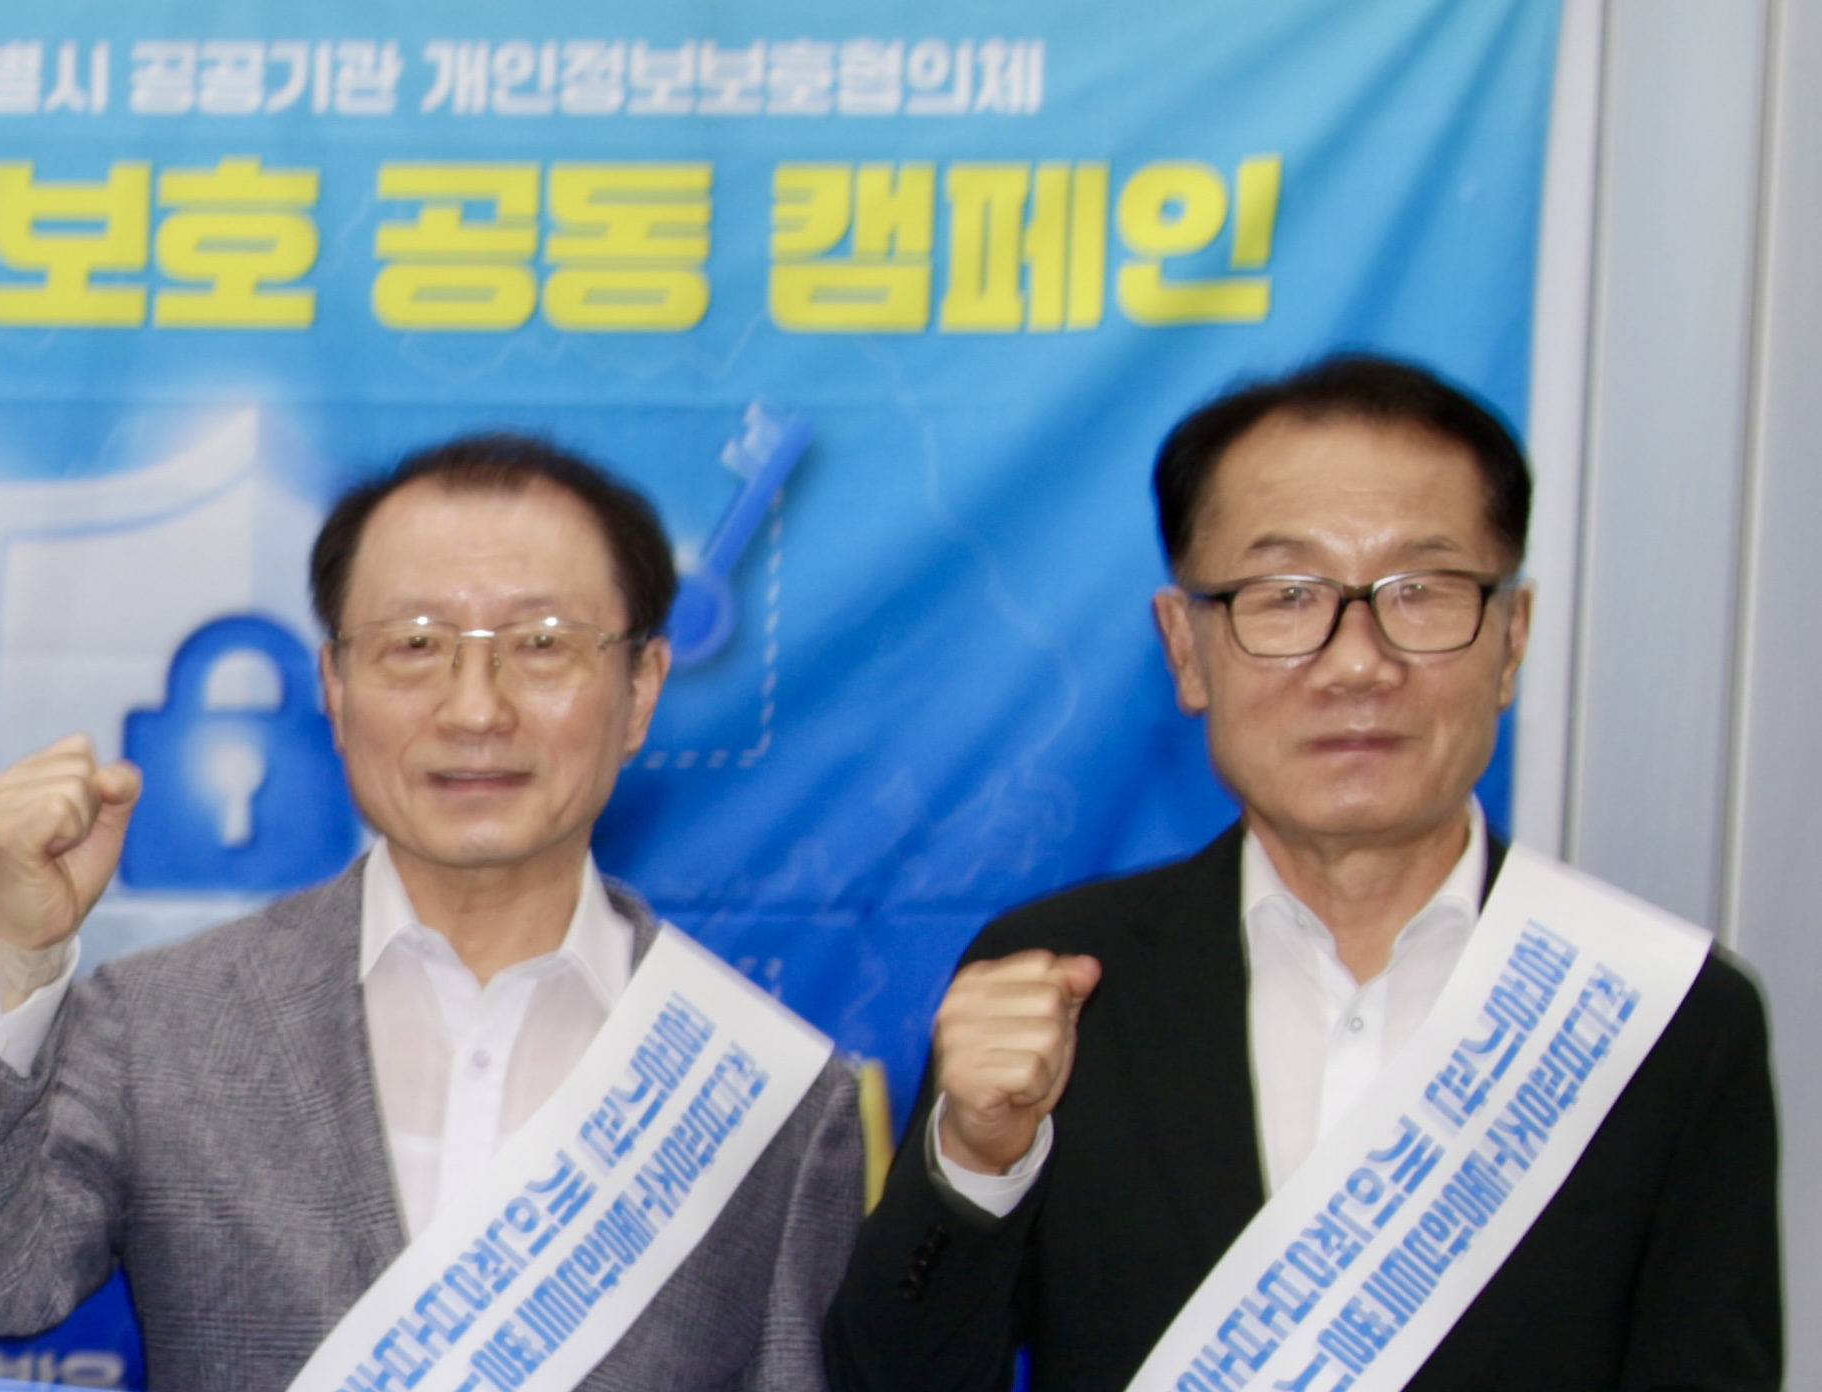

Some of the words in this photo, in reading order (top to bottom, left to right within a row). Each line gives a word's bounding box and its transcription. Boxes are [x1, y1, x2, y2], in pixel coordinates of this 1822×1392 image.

[129, 39, 403, 116] 공공기관
[421, 38, 1046, 116] 개인정보보호협의체
[371, 159, 715, 333] 공동
[768, 152, 1284, 333] 캠페인
[578, 990, 718, 1178] 공공기관
[1423, 918, 1580, 1129] 공공기관
